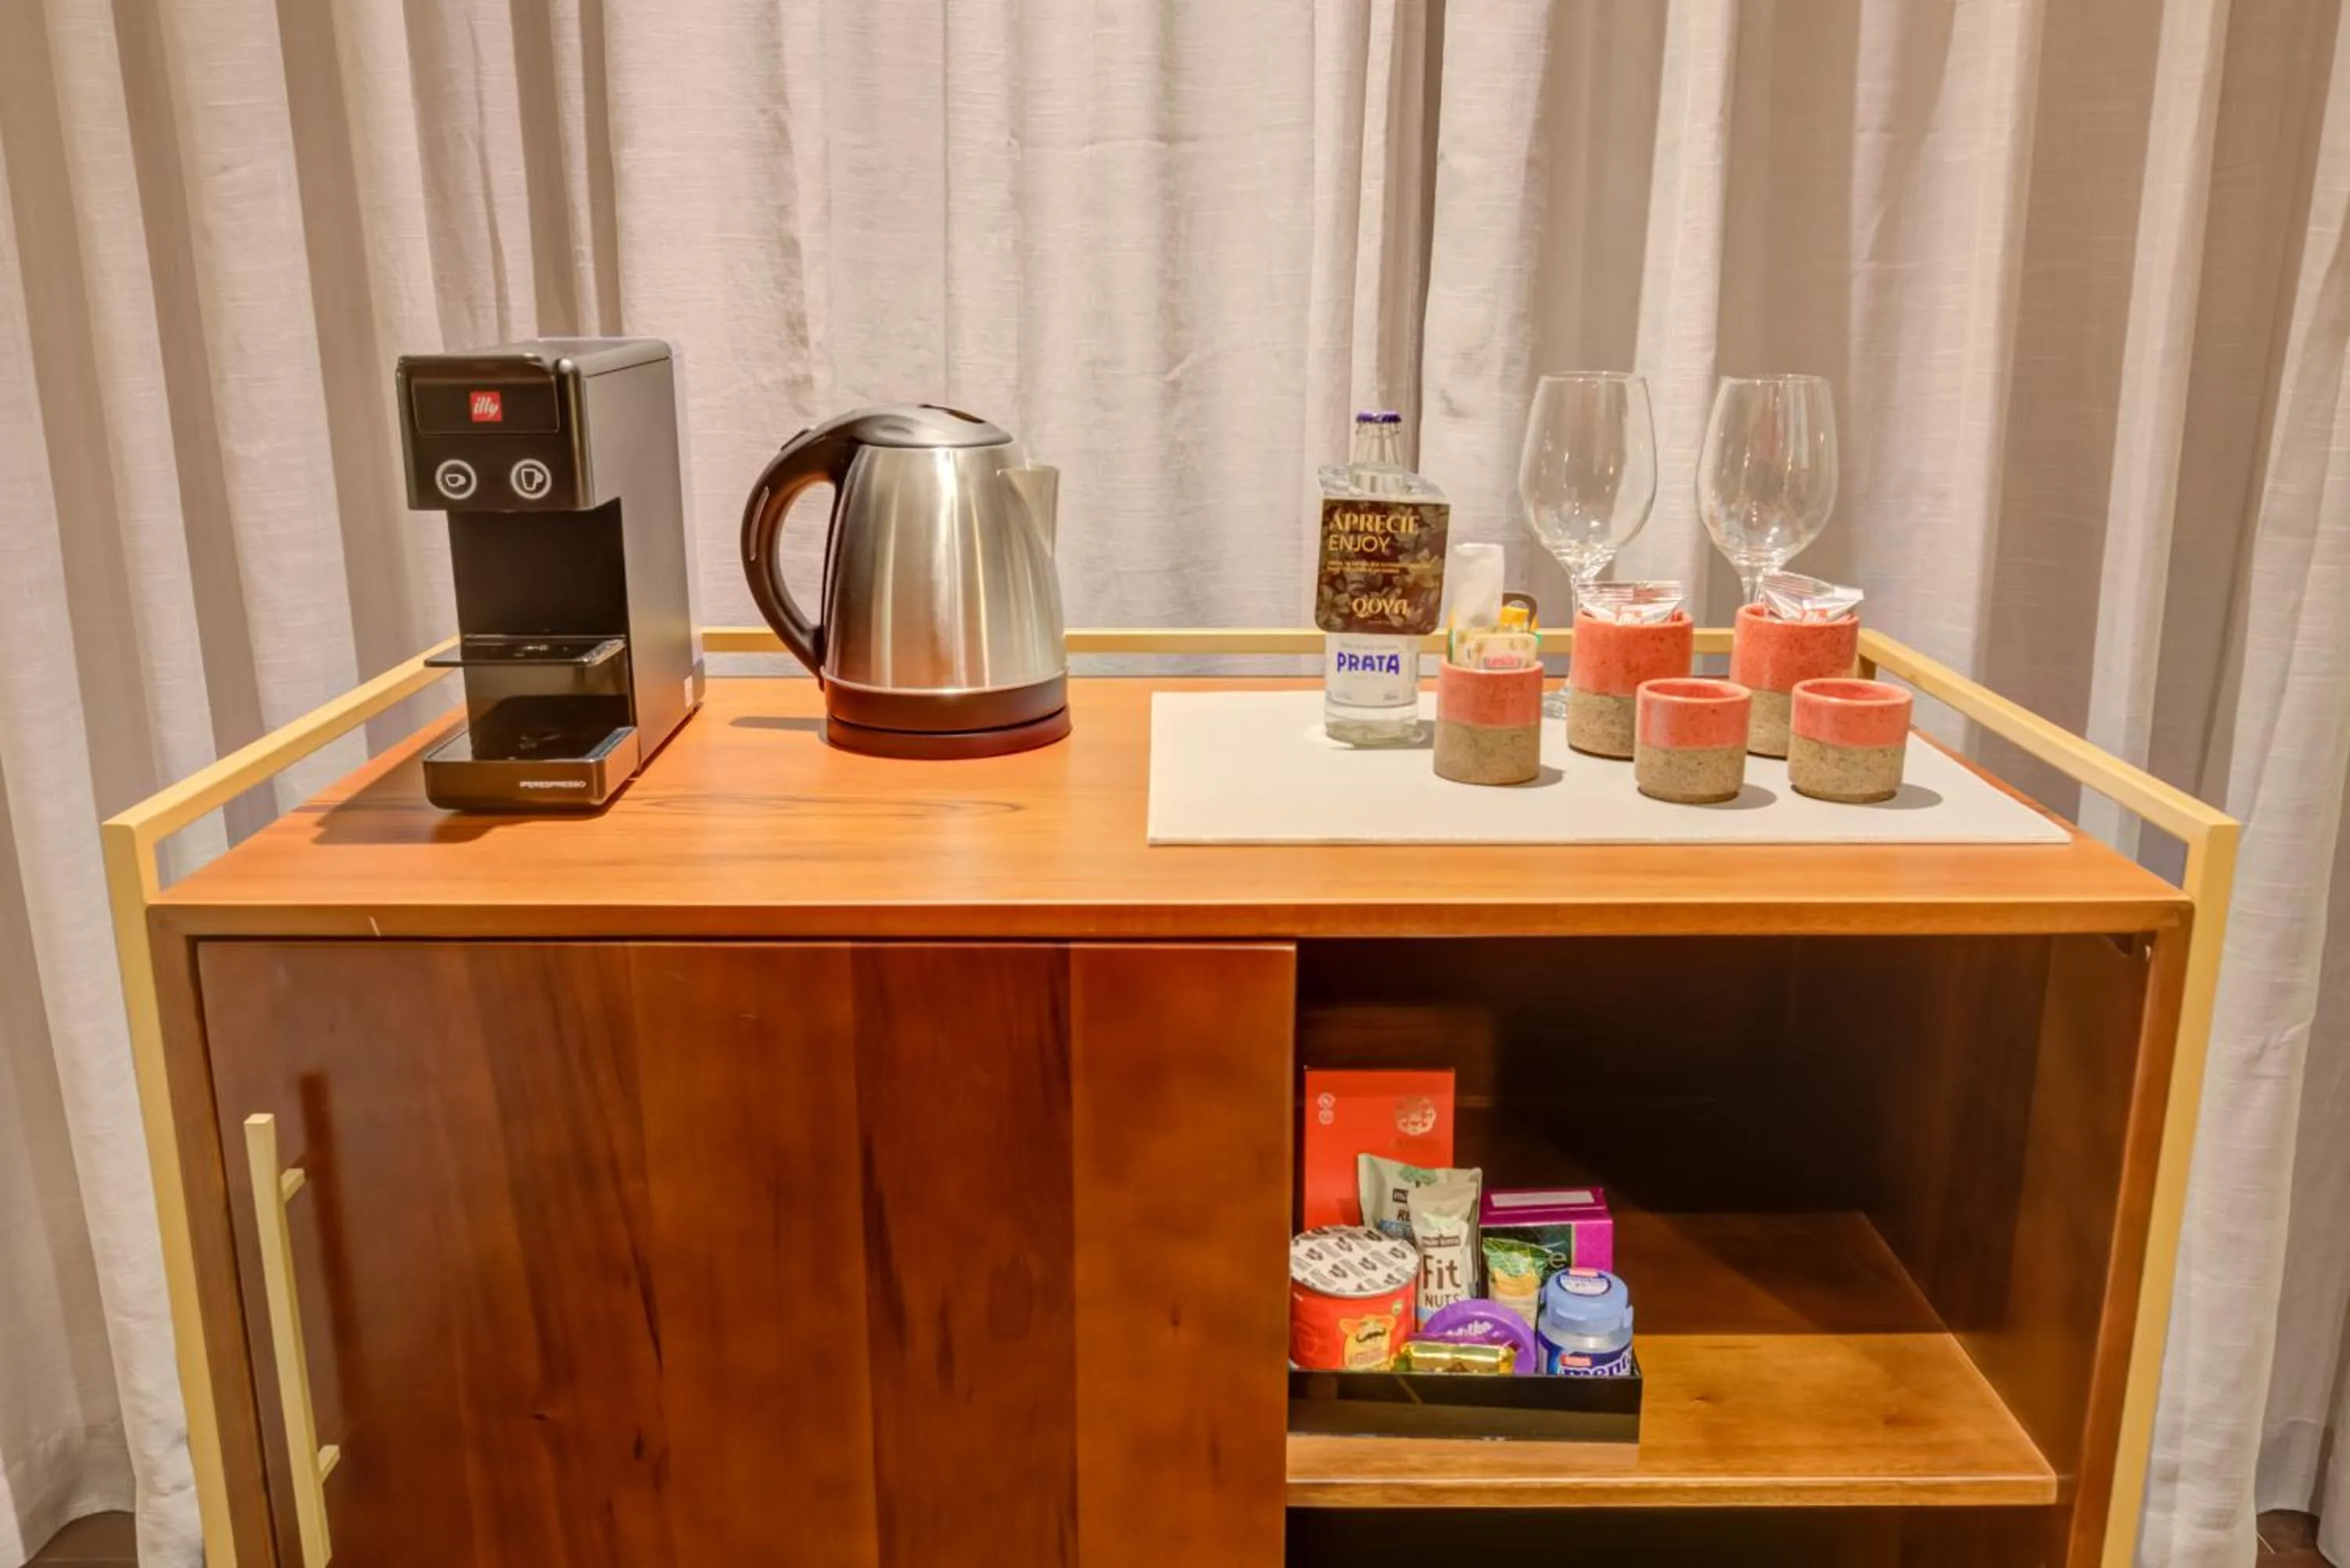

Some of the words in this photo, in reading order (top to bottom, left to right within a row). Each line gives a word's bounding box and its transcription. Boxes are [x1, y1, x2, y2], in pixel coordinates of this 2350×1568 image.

[473, 396, 500, 417] illy
[1330, 513, 1420, 534] APRECIE
[1329, 534, 1390, 553] ENJOY
[1336, 651, 1400, 676] PRATA
[1425, 1293, 1461, 1307] NUTS
